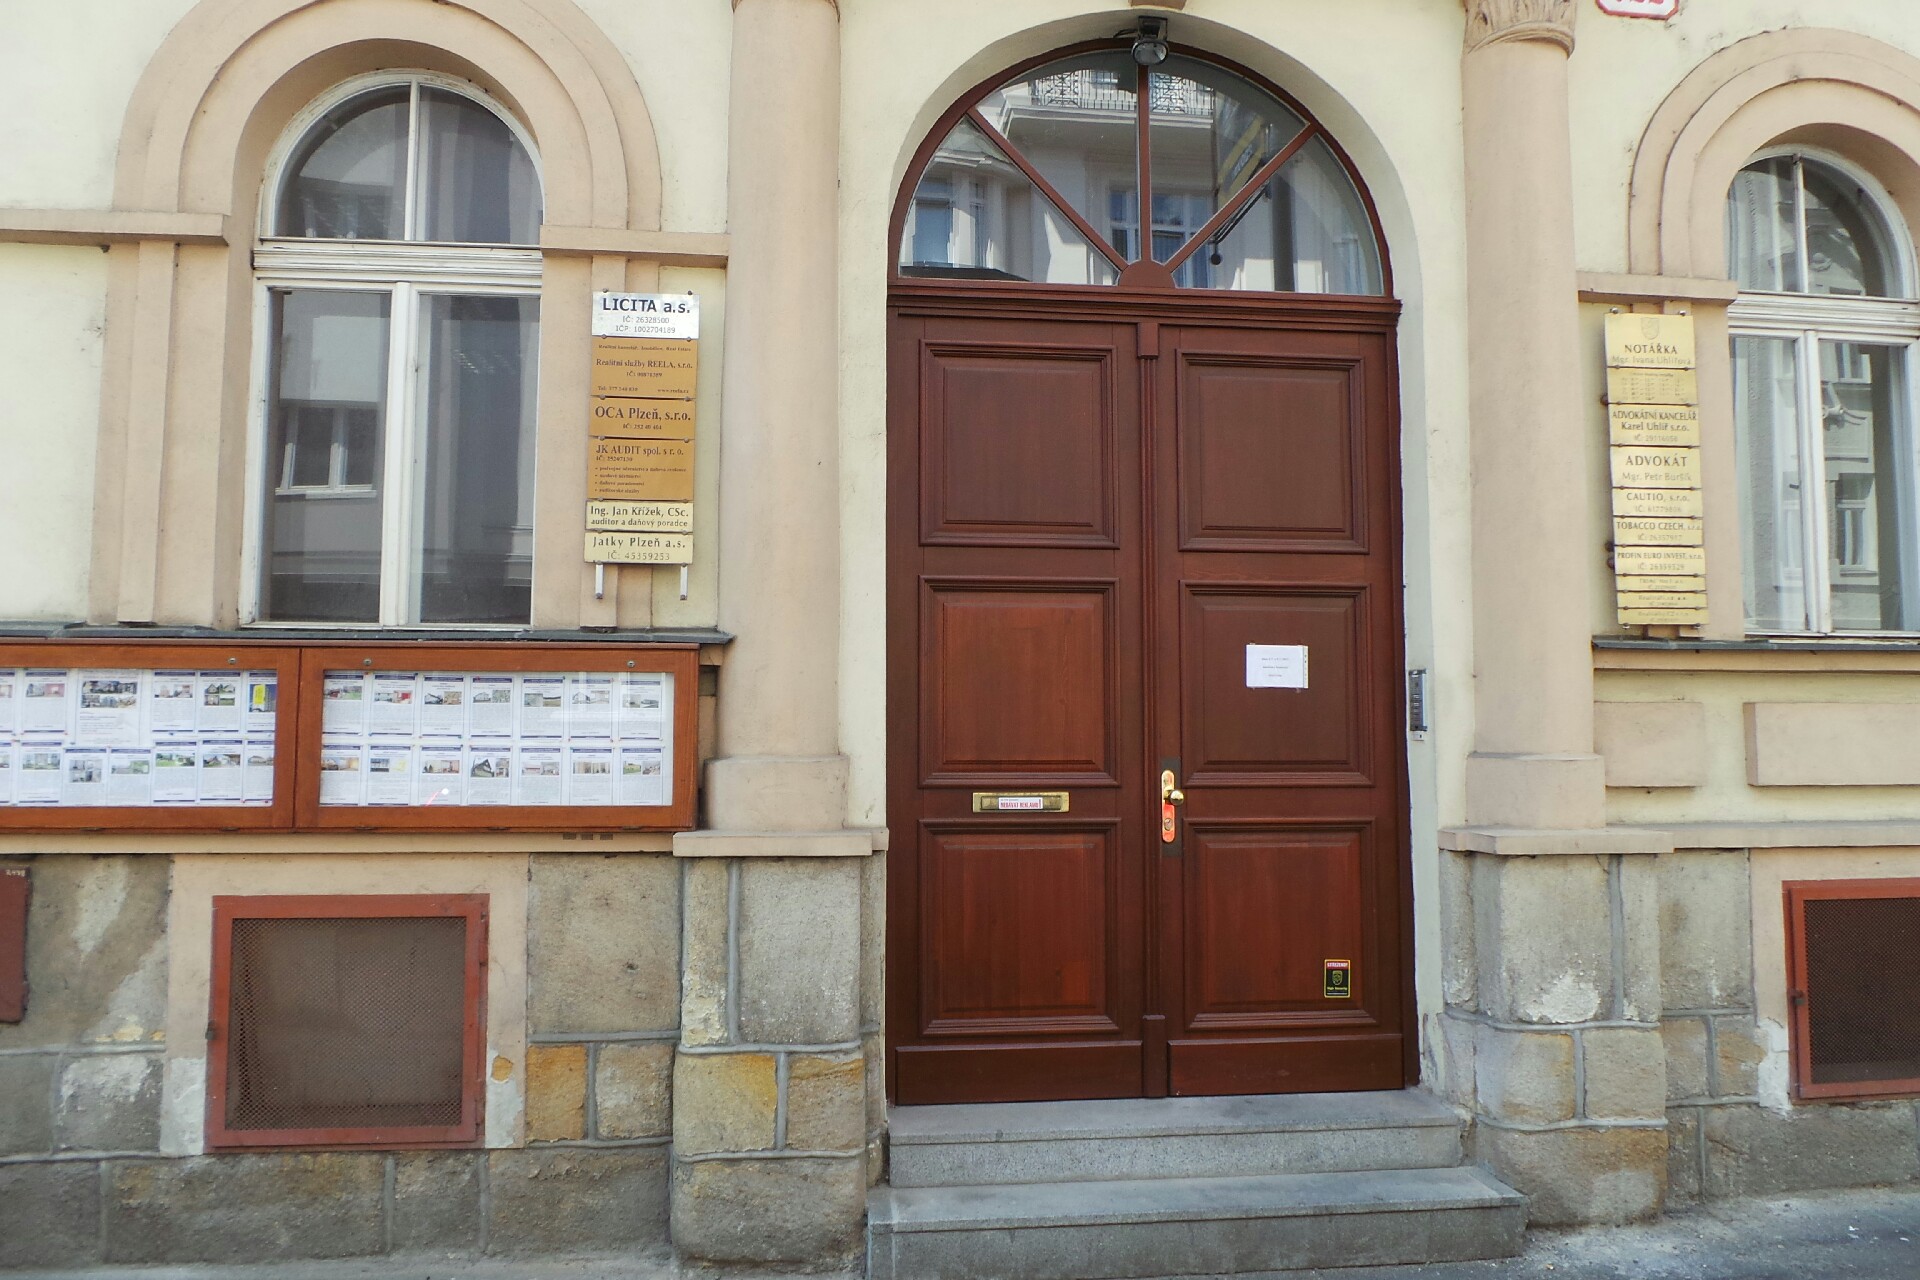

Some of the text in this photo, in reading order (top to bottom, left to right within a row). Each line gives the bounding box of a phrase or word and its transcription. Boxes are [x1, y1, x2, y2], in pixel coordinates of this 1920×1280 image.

[602, 298, 691, 313] LICITA a.s.
[622, 315, 670, 324] IČ: 26328500
[615, 324, 676, 334] IČP: 1002704189
[1624, 343, 1678, 354] NOTÁŘKA
[596, 358, 693, 369] Realitní služby REELA, s.r.o.
[594, 406, 691, 421] OCA Plzeň, s.r.o.
[1612, 408, 1697, 421] ADVOKÁTNÍ KANCELÁŘ
[1622, 422, 1644, 430] Karel
[596, 444, 608, 454] JK
[610, 444, 641, 455] AUDIT
[643, 446, 661, 456] spol.
[1625, 453, 1688, 467] ADVOKÁT
[1644, 472, 1663, 480] Petr
[1626, 492, 1666, 502] CAUTIO,
[590, 506, 689, 518] Ing. Jan Křížek, CSc.
[628, 518, 655, 527] daňový
[658, 519, 688, 527] poradce
[1616, 522, 1656, 530] TOBACCO
[592, 536, 686, 549] Jatky Plzeň a.s.
[608, 550, 670, 560] IČ: 45359253
